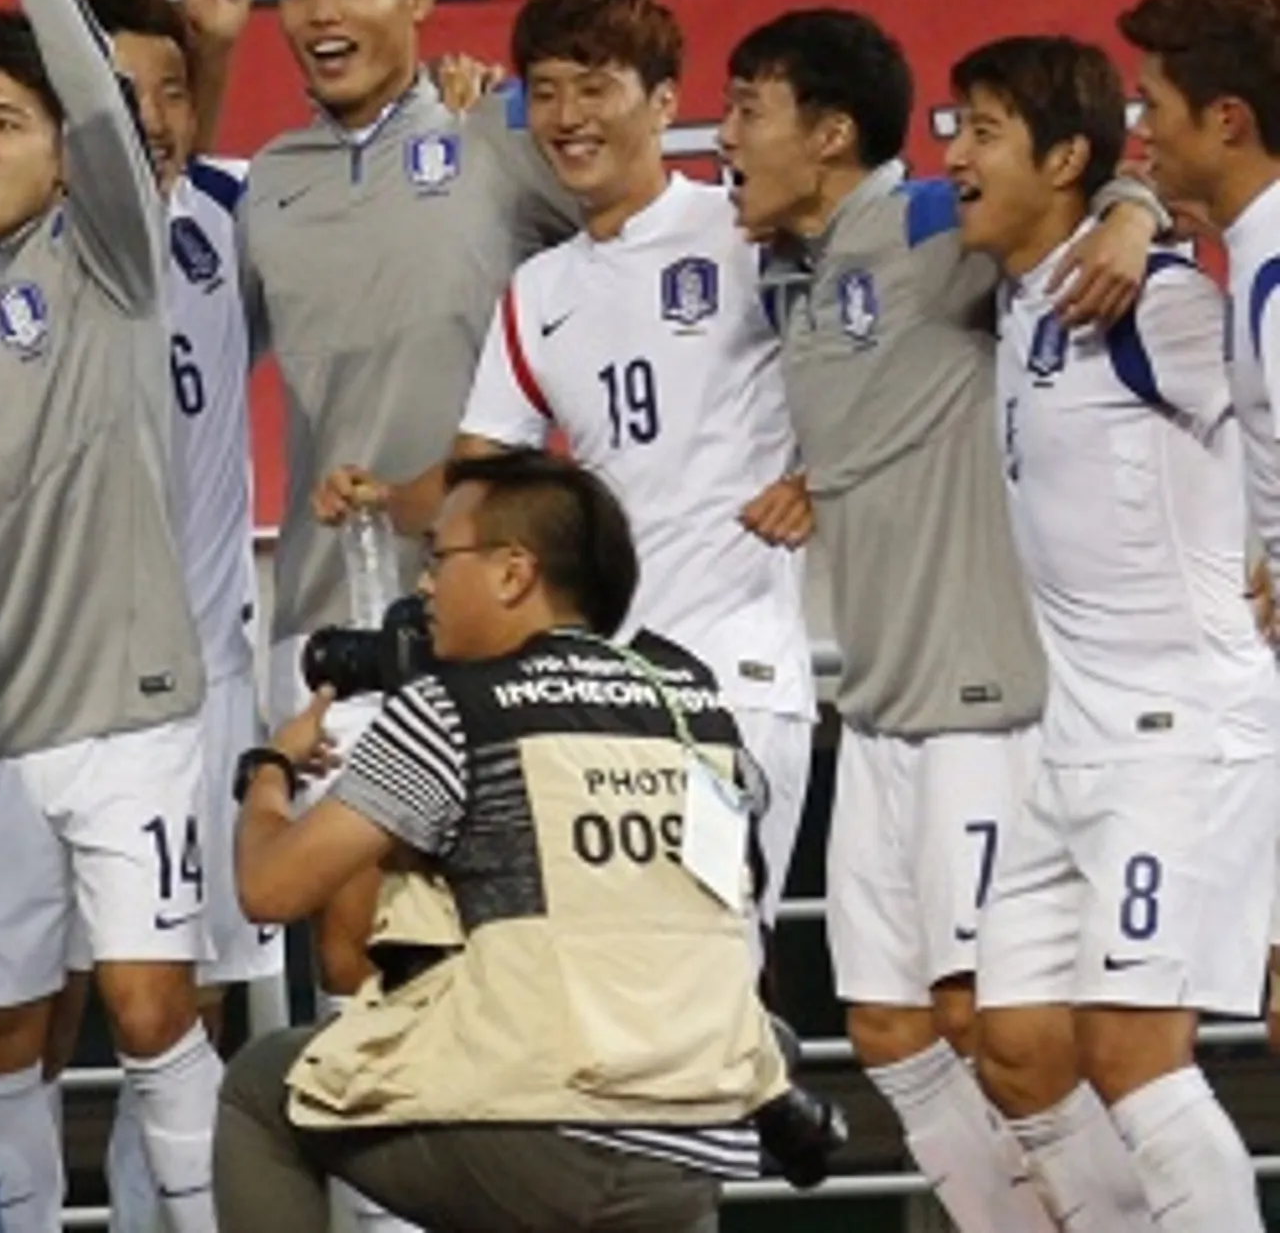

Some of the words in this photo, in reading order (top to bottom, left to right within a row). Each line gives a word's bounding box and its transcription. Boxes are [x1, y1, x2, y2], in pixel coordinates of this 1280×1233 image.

[598, 357, 660, 450] 19
[493, 677, 659, 709] INCHEON
[141, 814, 203, 904] 14
[964, 820, 999, 910] 7
[1119, 850, 1163, 941] 8
